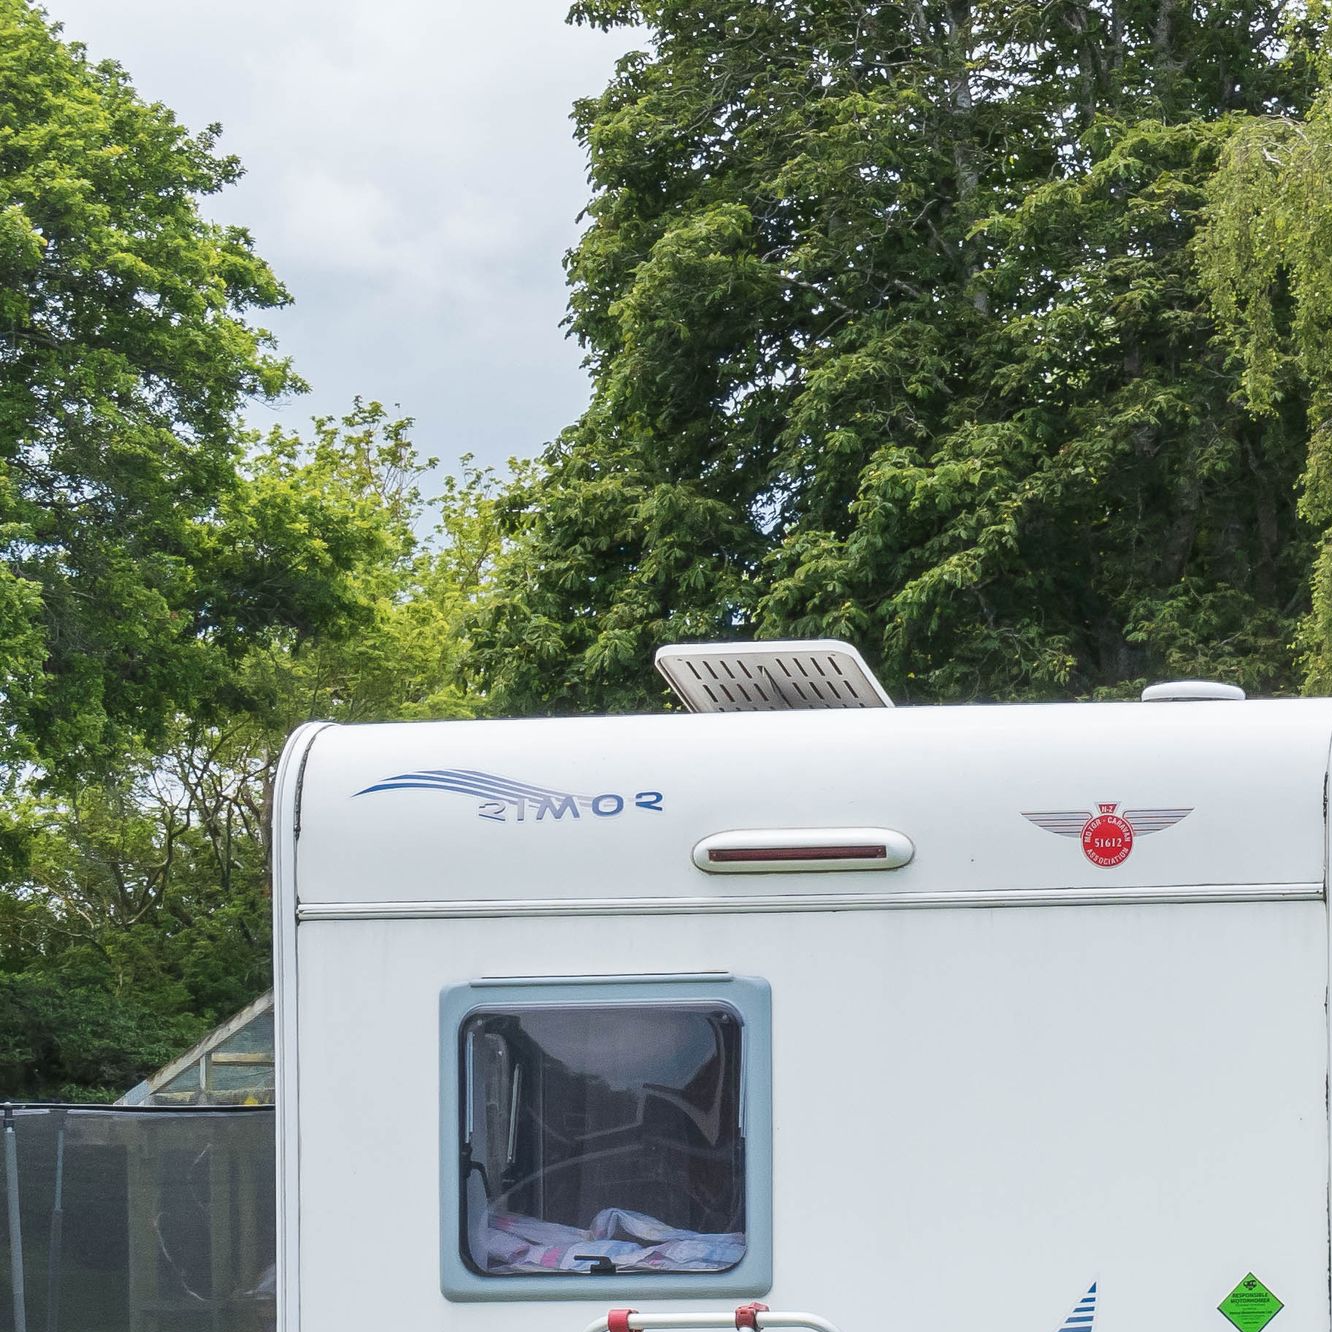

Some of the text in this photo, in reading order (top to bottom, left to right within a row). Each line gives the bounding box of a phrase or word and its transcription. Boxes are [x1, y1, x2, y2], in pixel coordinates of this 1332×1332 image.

[1084, 816, 1131, 843] MOTOR CARAVAN
[1094, 837, 1122, 848] 51612
[1086, 847, 1129, 865] ASSOCIATION
